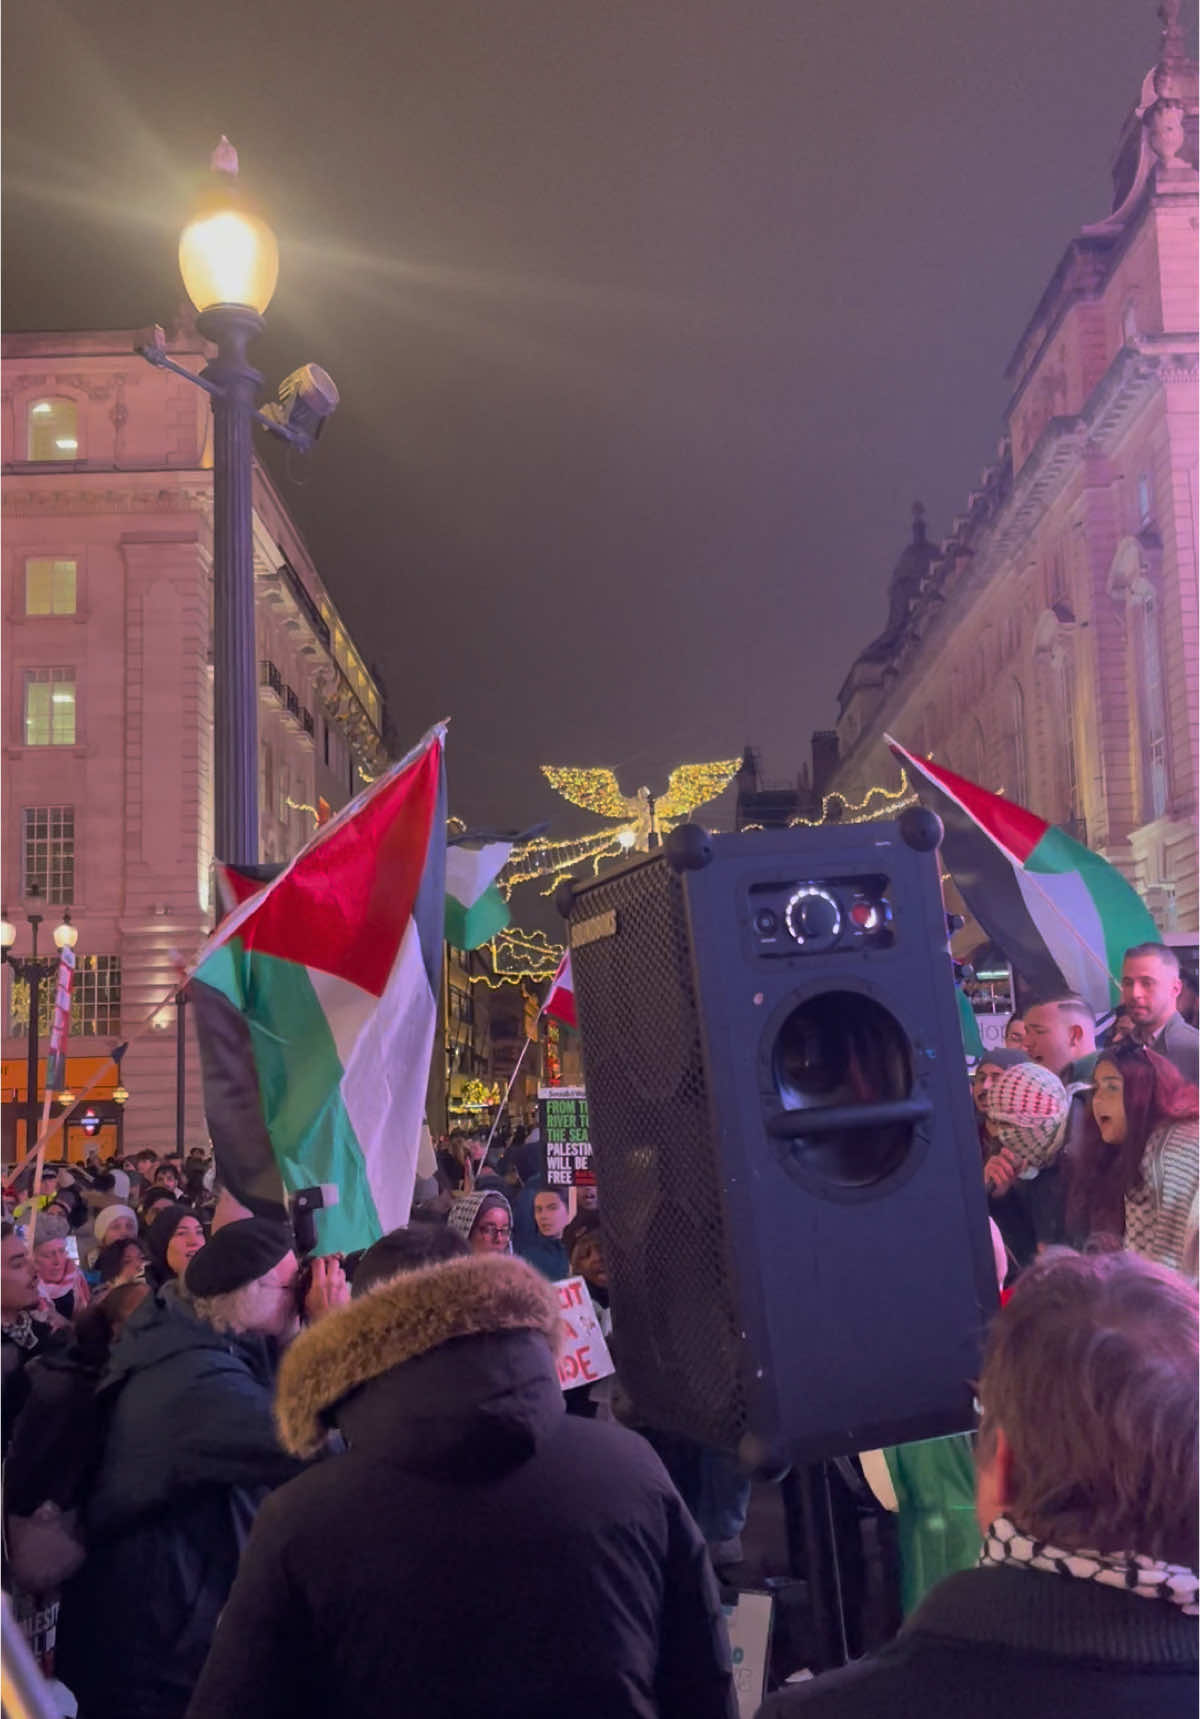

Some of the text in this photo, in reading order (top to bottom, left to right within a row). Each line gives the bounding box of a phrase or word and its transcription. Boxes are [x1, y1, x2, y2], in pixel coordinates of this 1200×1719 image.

[546, 1100, 576, 1114] FROM
[546, 1114, 577, 1128] RIVER
[547, 1128, 589, 1142] THE SEA
[547, 1156, 588, 1170] WILL BE
[547, 1170, 573, 1185] FREE
